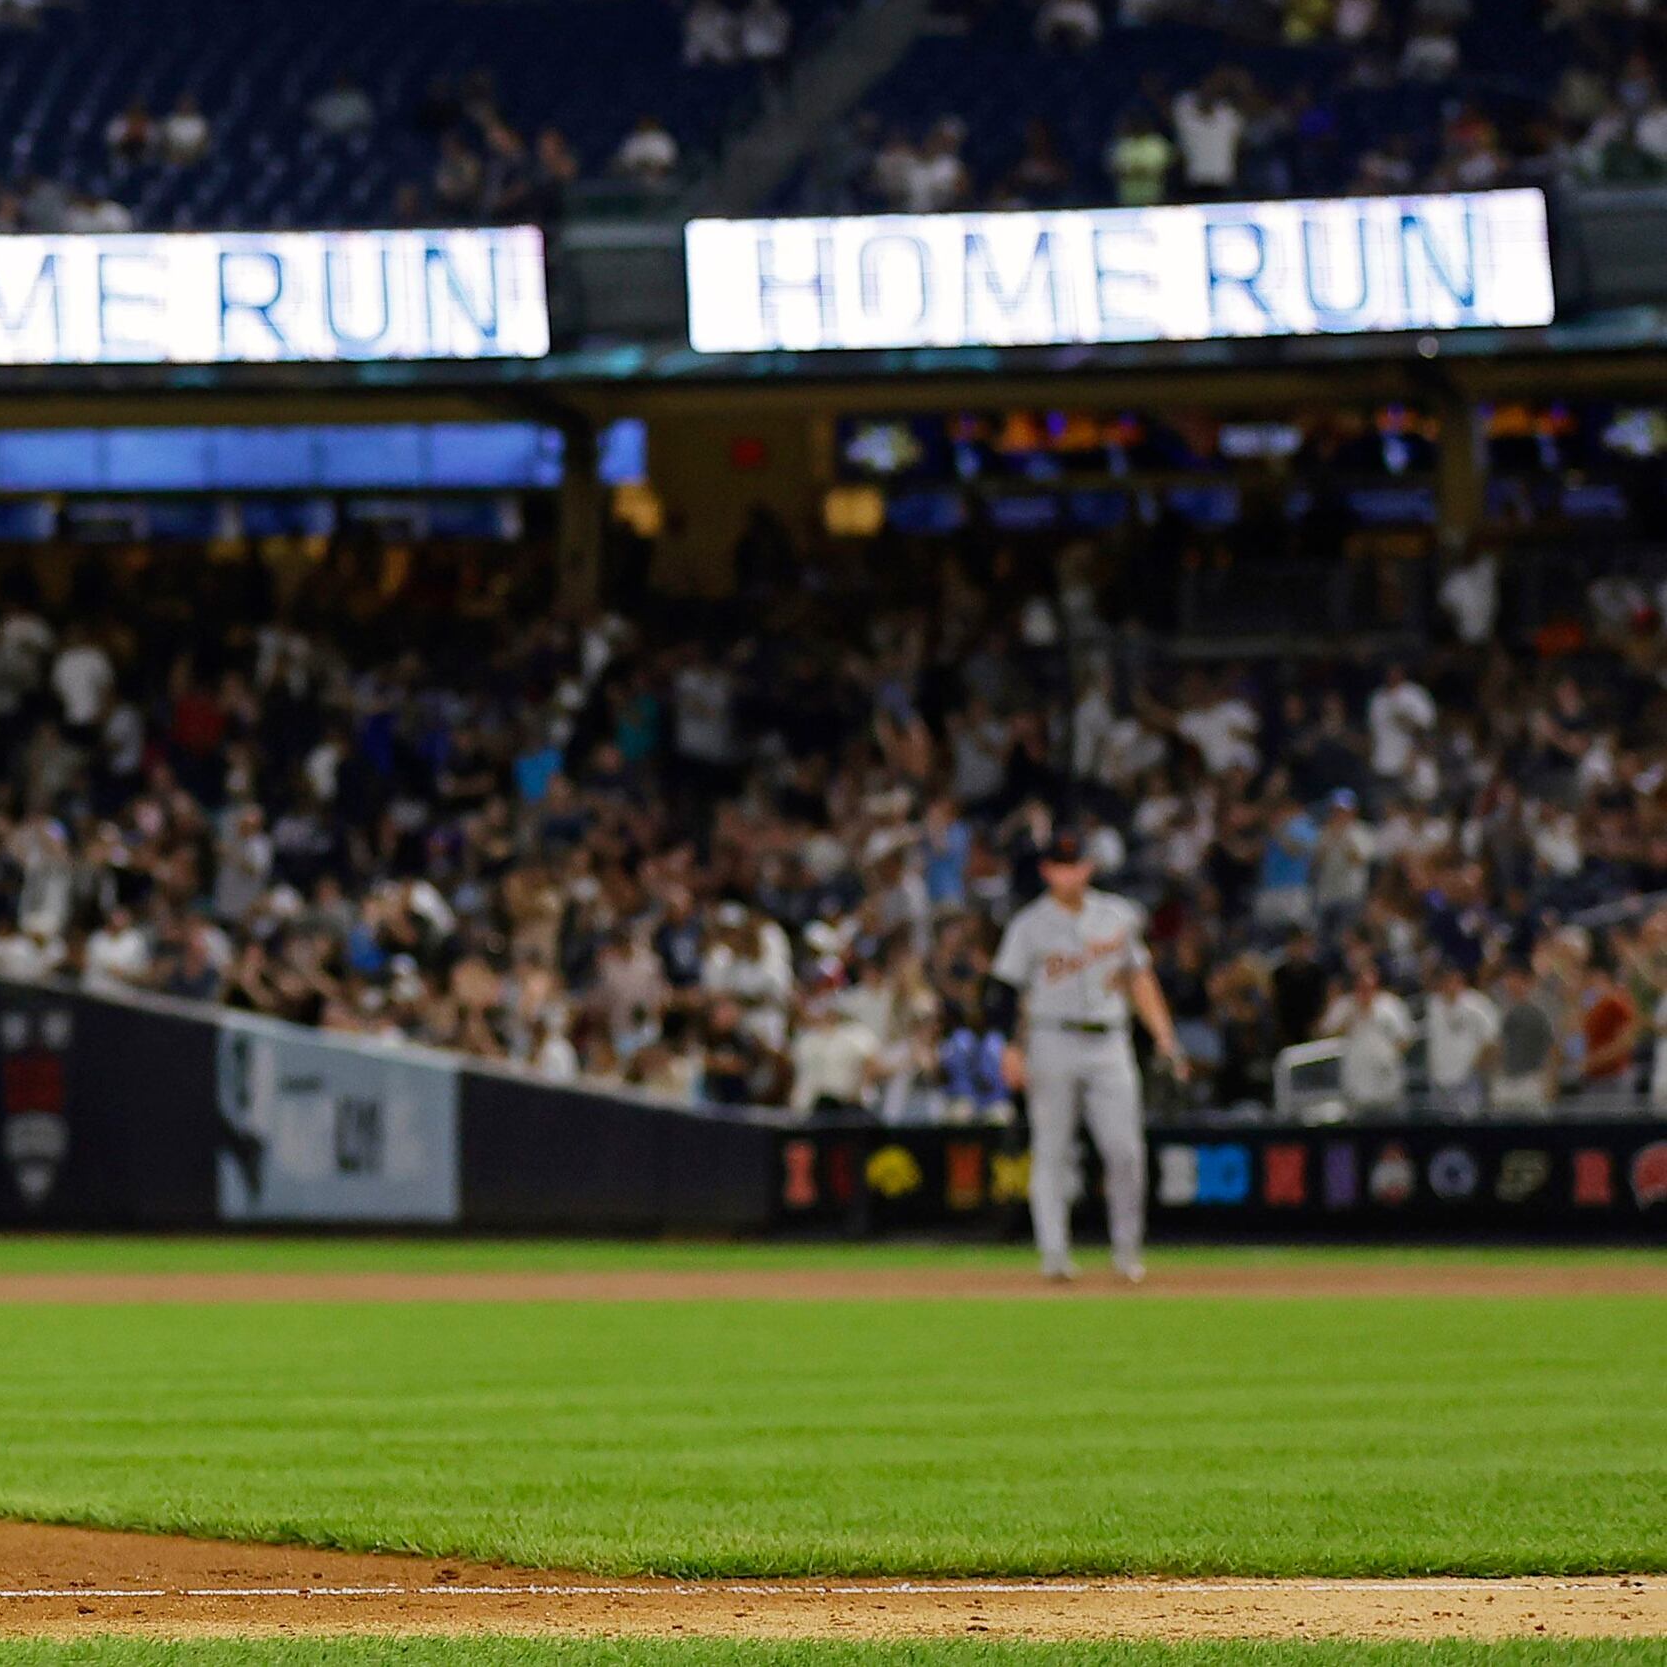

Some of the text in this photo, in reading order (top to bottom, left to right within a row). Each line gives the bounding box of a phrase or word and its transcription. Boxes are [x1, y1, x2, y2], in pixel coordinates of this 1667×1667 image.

[216, 242, 503, 350] RUN
[755, 210, 1479, 346] HOME RUN
